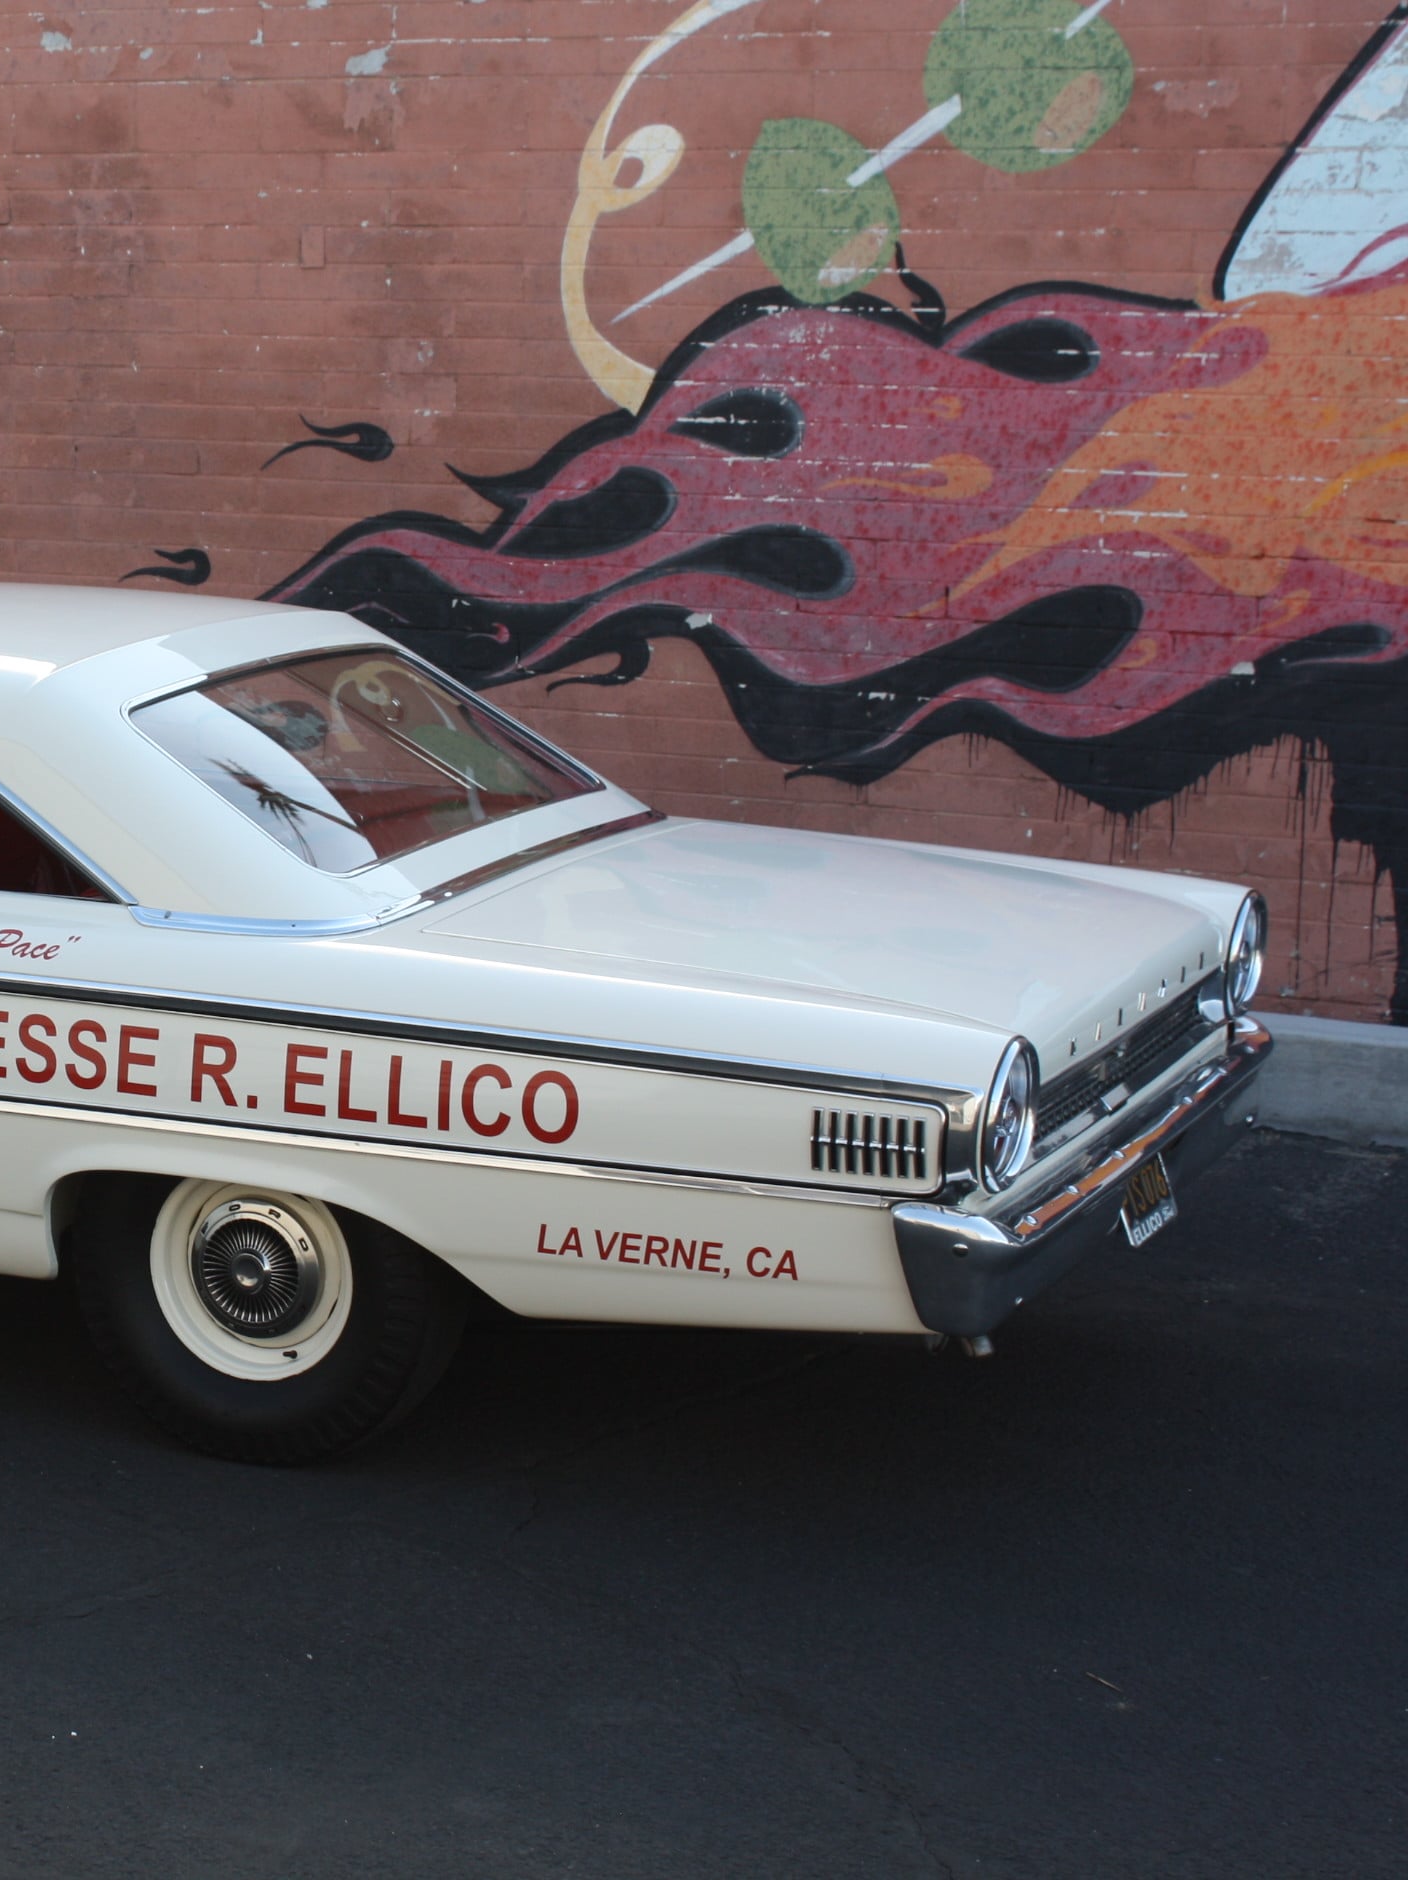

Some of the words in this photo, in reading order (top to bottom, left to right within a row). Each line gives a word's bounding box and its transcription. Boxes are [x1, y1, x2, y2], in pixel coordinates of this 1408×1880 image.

[190, 1033, 258, 1110] R.
[283, 1043, 580, 1145] ELLICO
[536, 1223, 584, 1258] LA
[594, 1229, 731, 1279] VERNE,
[745, 1246, 799, 1281] CA
